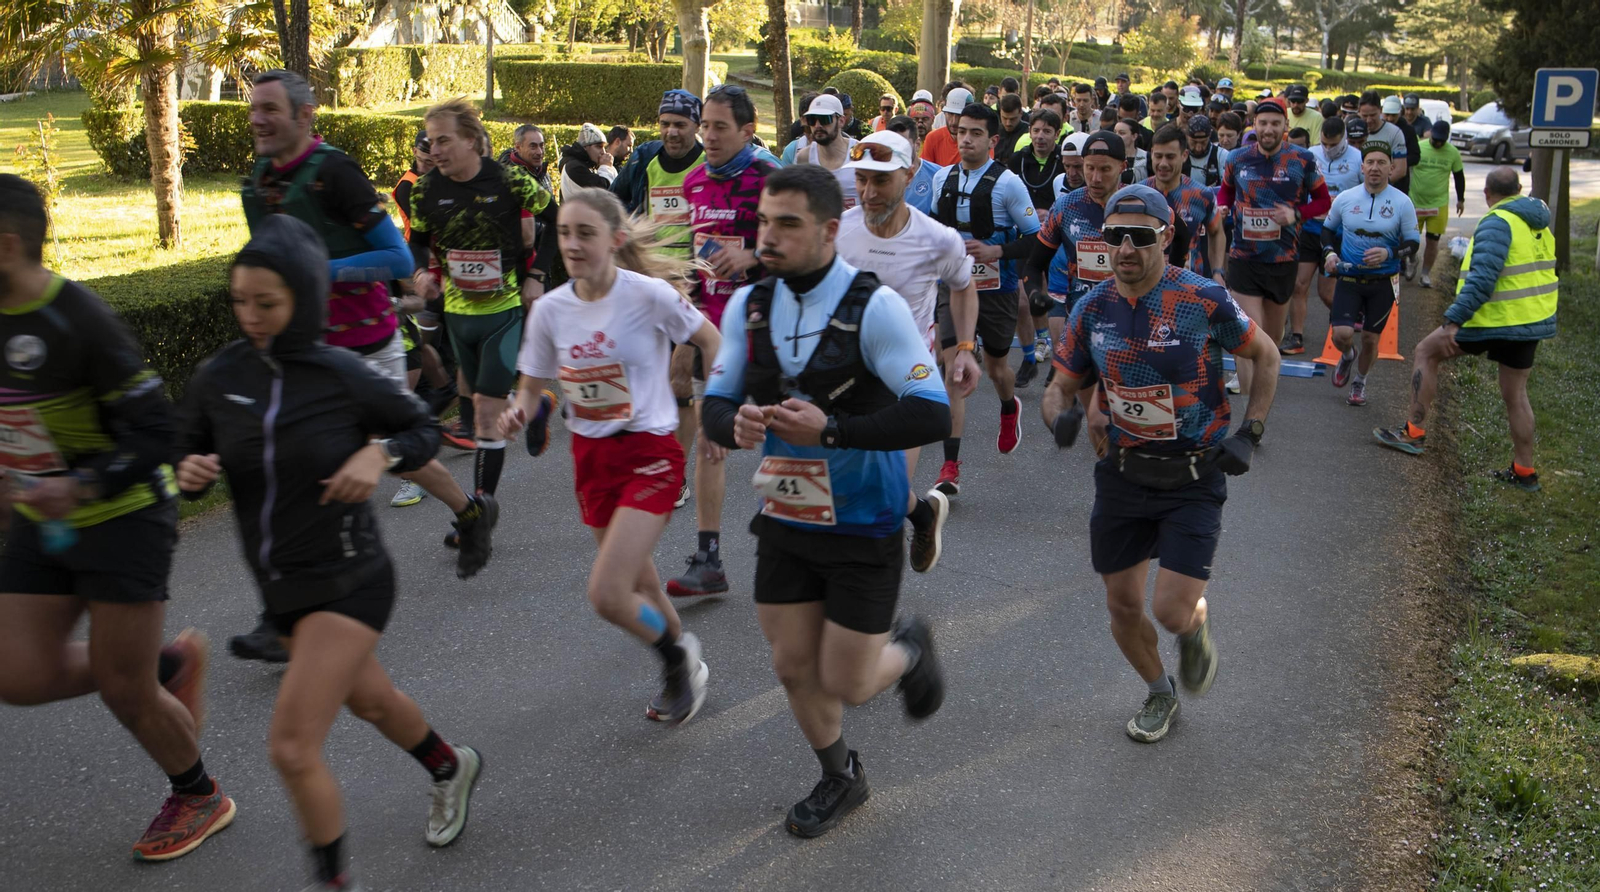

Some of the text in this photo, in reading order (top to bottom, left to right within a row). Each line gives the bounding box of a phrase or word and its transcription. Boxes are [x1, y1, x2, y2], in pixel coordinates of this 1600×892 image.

[1544, 75, 1584, 122] P
[663, 197, 679, 208] 30
[1251, 218, 1269, 226] 103
[1097, 254, 1105, 265] 8
[460, 262, 486, 274] 129
[971, 264, 985, 275] 02
[579, 383, 599, 399] 17
[1122, 401, 1144, 416] 29
[775, 478, 801, 495] 41
